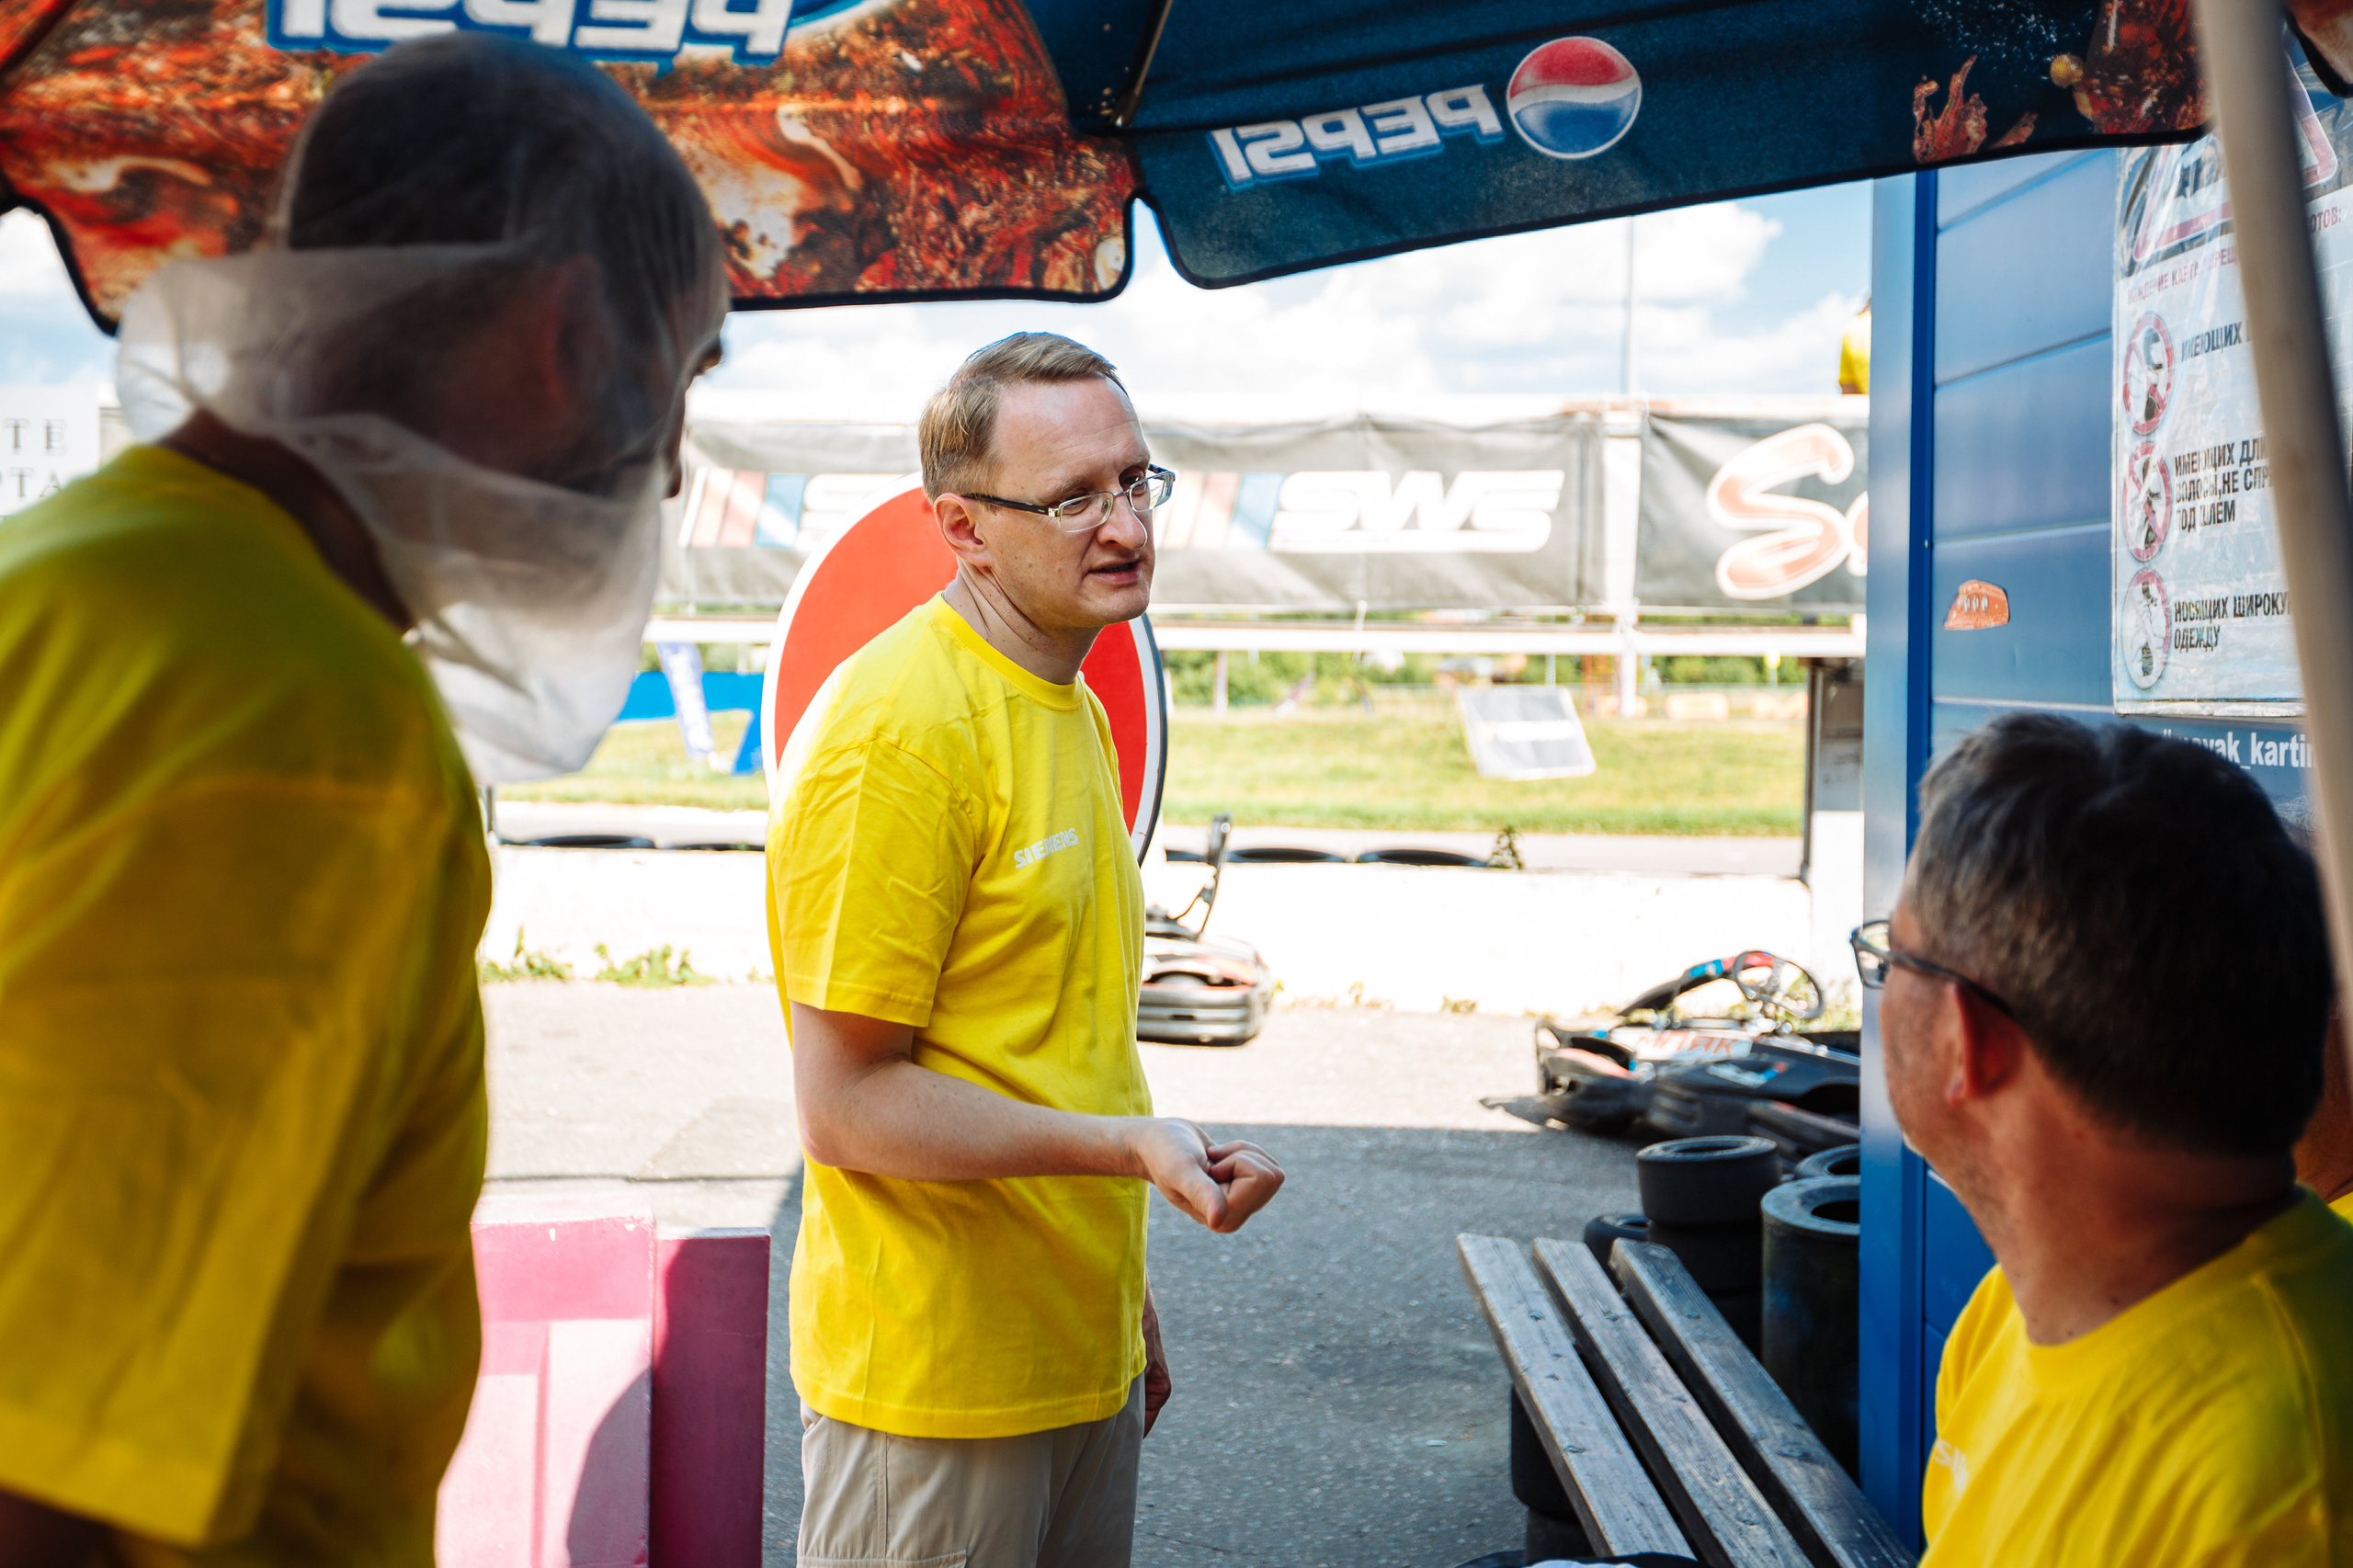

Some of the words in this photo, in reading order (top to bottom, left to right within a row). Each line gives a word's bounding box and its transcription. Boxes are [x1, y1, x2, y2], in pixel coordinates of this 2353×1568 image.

[2181, 322, 2243, 362] ИМЕЮЩИХ
[2175, 442, 2235, 477] ИМЕЮЩИХ
[1268, 469, 1565, 553] SWS
[2176, 506, 2197, 533] ПОД
[2200, 499, 2235, 528] ШЛЕМ
[2174, 597, 2229, 624] НОСЯЩИХ
[2174, 625, 2221, 653] ОДЕЖДУ
[1013, 827, 1078, 869] SIEMENS
